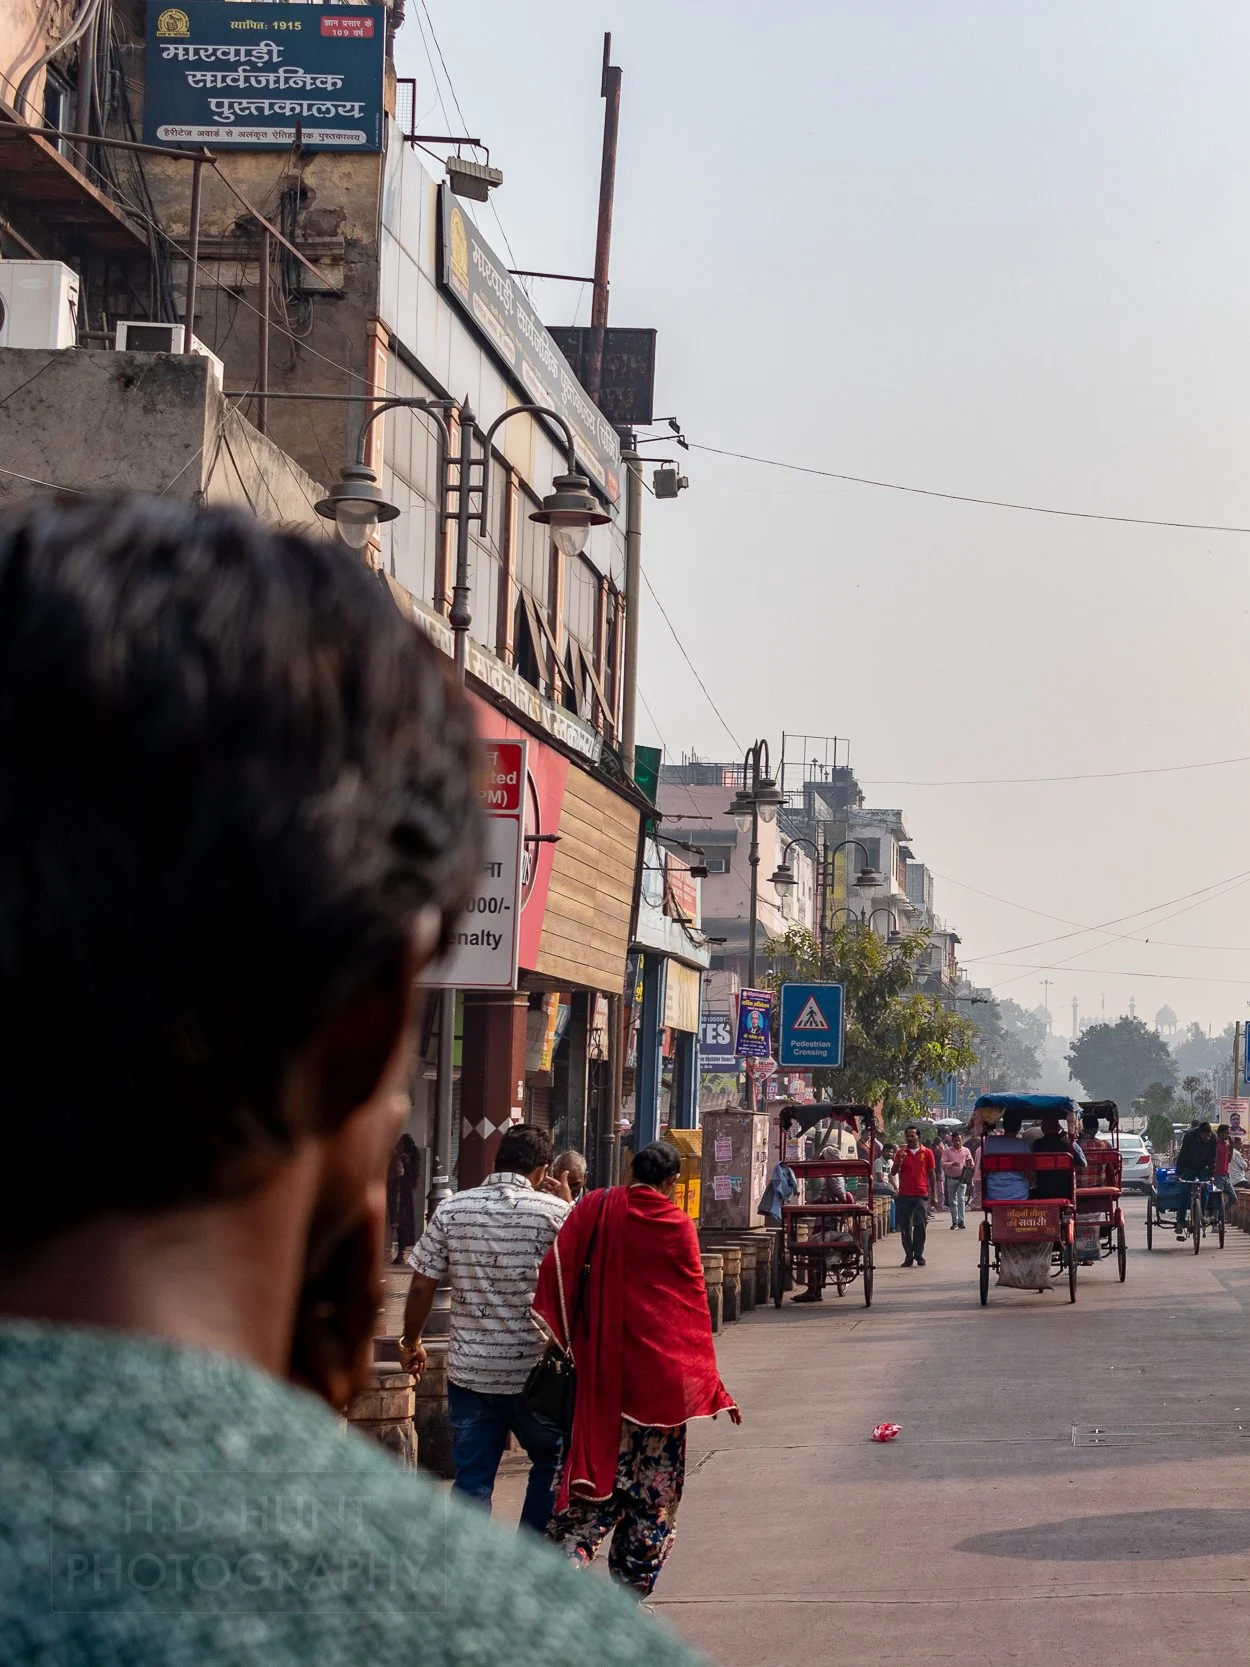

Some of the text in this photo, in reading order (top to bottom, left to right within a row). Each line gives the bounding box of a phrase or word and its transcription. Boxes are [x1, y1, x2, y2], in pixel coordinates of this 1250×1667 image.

[272, 21, 302, 31] 1915
[342, 19, 361, 28] प्रसार
[364, 18, 372, 28] के
[332, 29, 349, 37] 109
[160, 40, 284, 67] मारवाड़ी
[185, 66, 345, 91] सार्वजनिक
[208, 98, 366, 123] पुस्तकालय
[226, 129, 233, 138] से
[318, 131, 361, 142] पुस्तकालय
[791, 1040, 831, 1048] Pedestrian
[793, 1048, 828, 1056] Crossing
